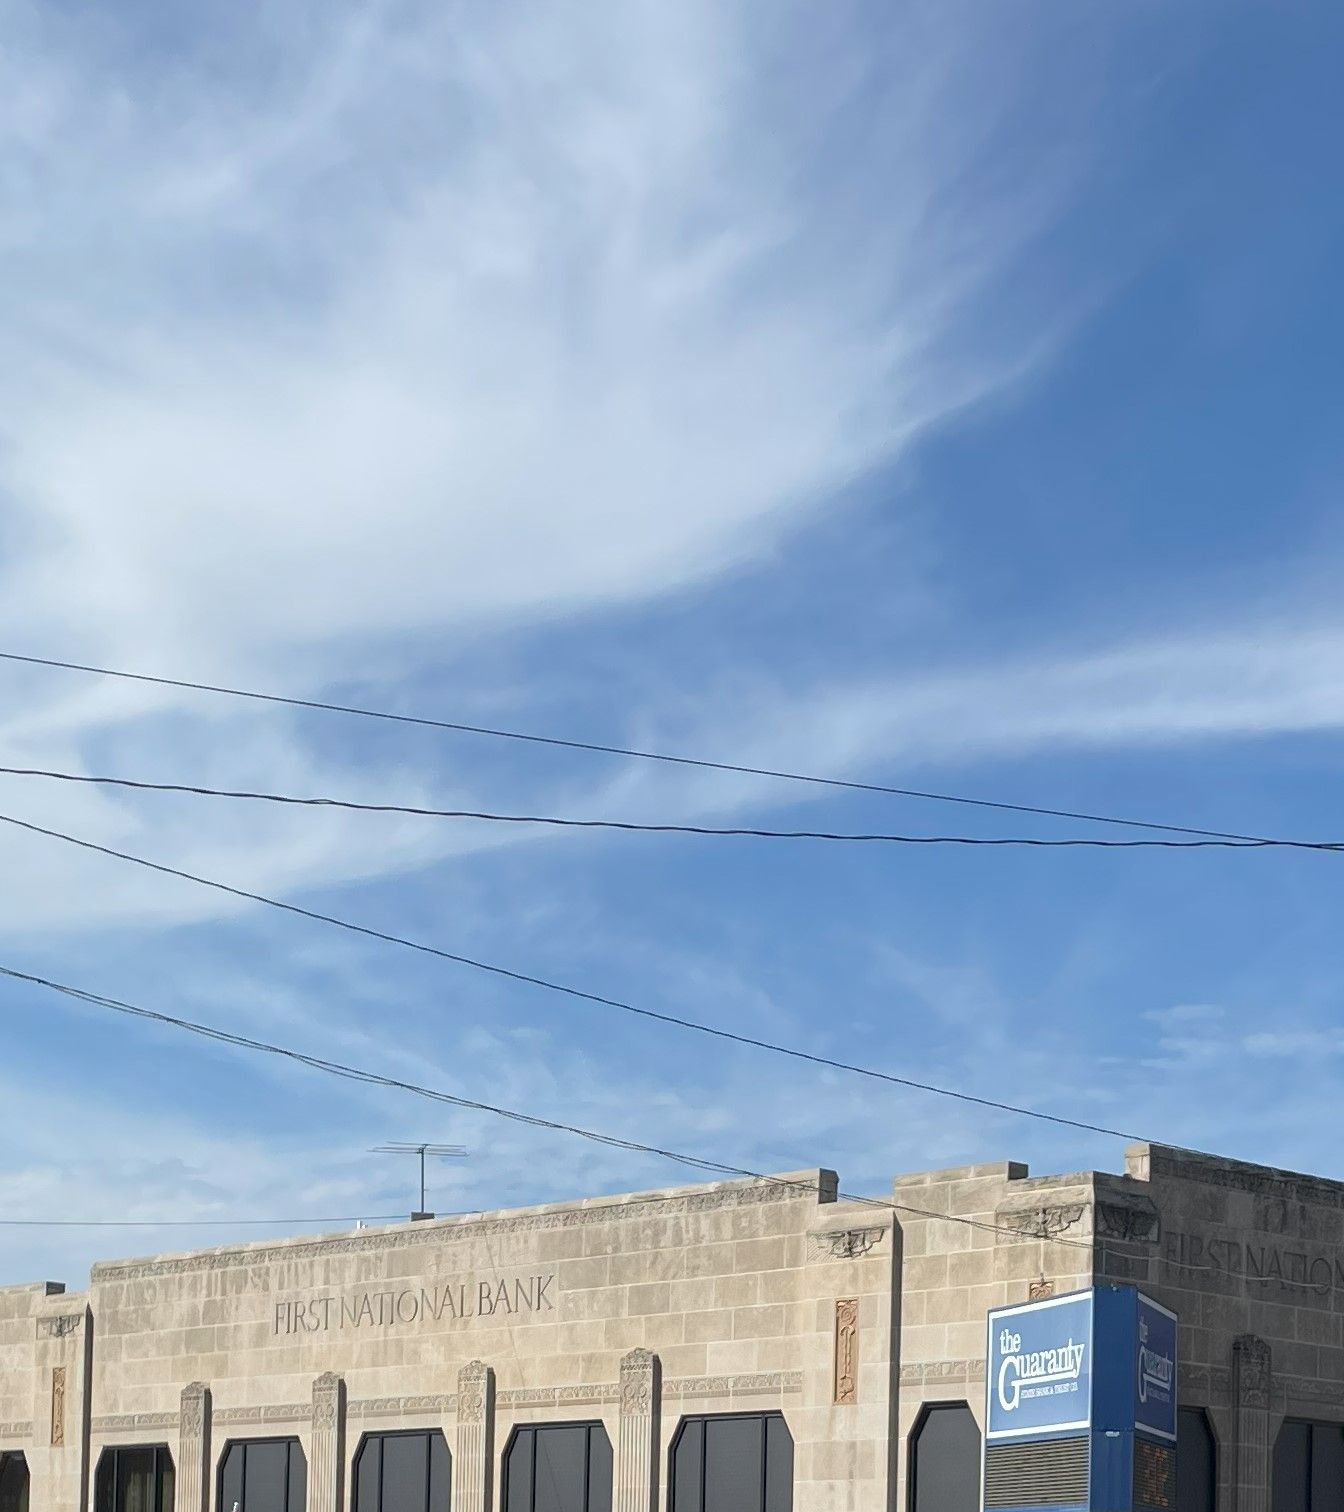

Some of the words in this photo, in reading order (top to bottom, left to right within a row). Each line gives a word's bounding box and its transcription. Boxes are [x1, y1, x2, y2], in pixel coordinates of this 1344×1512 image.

[1164, 1231, 1241, 1281] FIRST
[273, 1297, 335, 1335] FIRST
[340, 1284, 473, 1329] NATIONAL
[478, 1275, 555, 1318] BANK
[1000, 1328, 1021, 1354] the
[998, 1337, 1085, 1411] Guaranty
